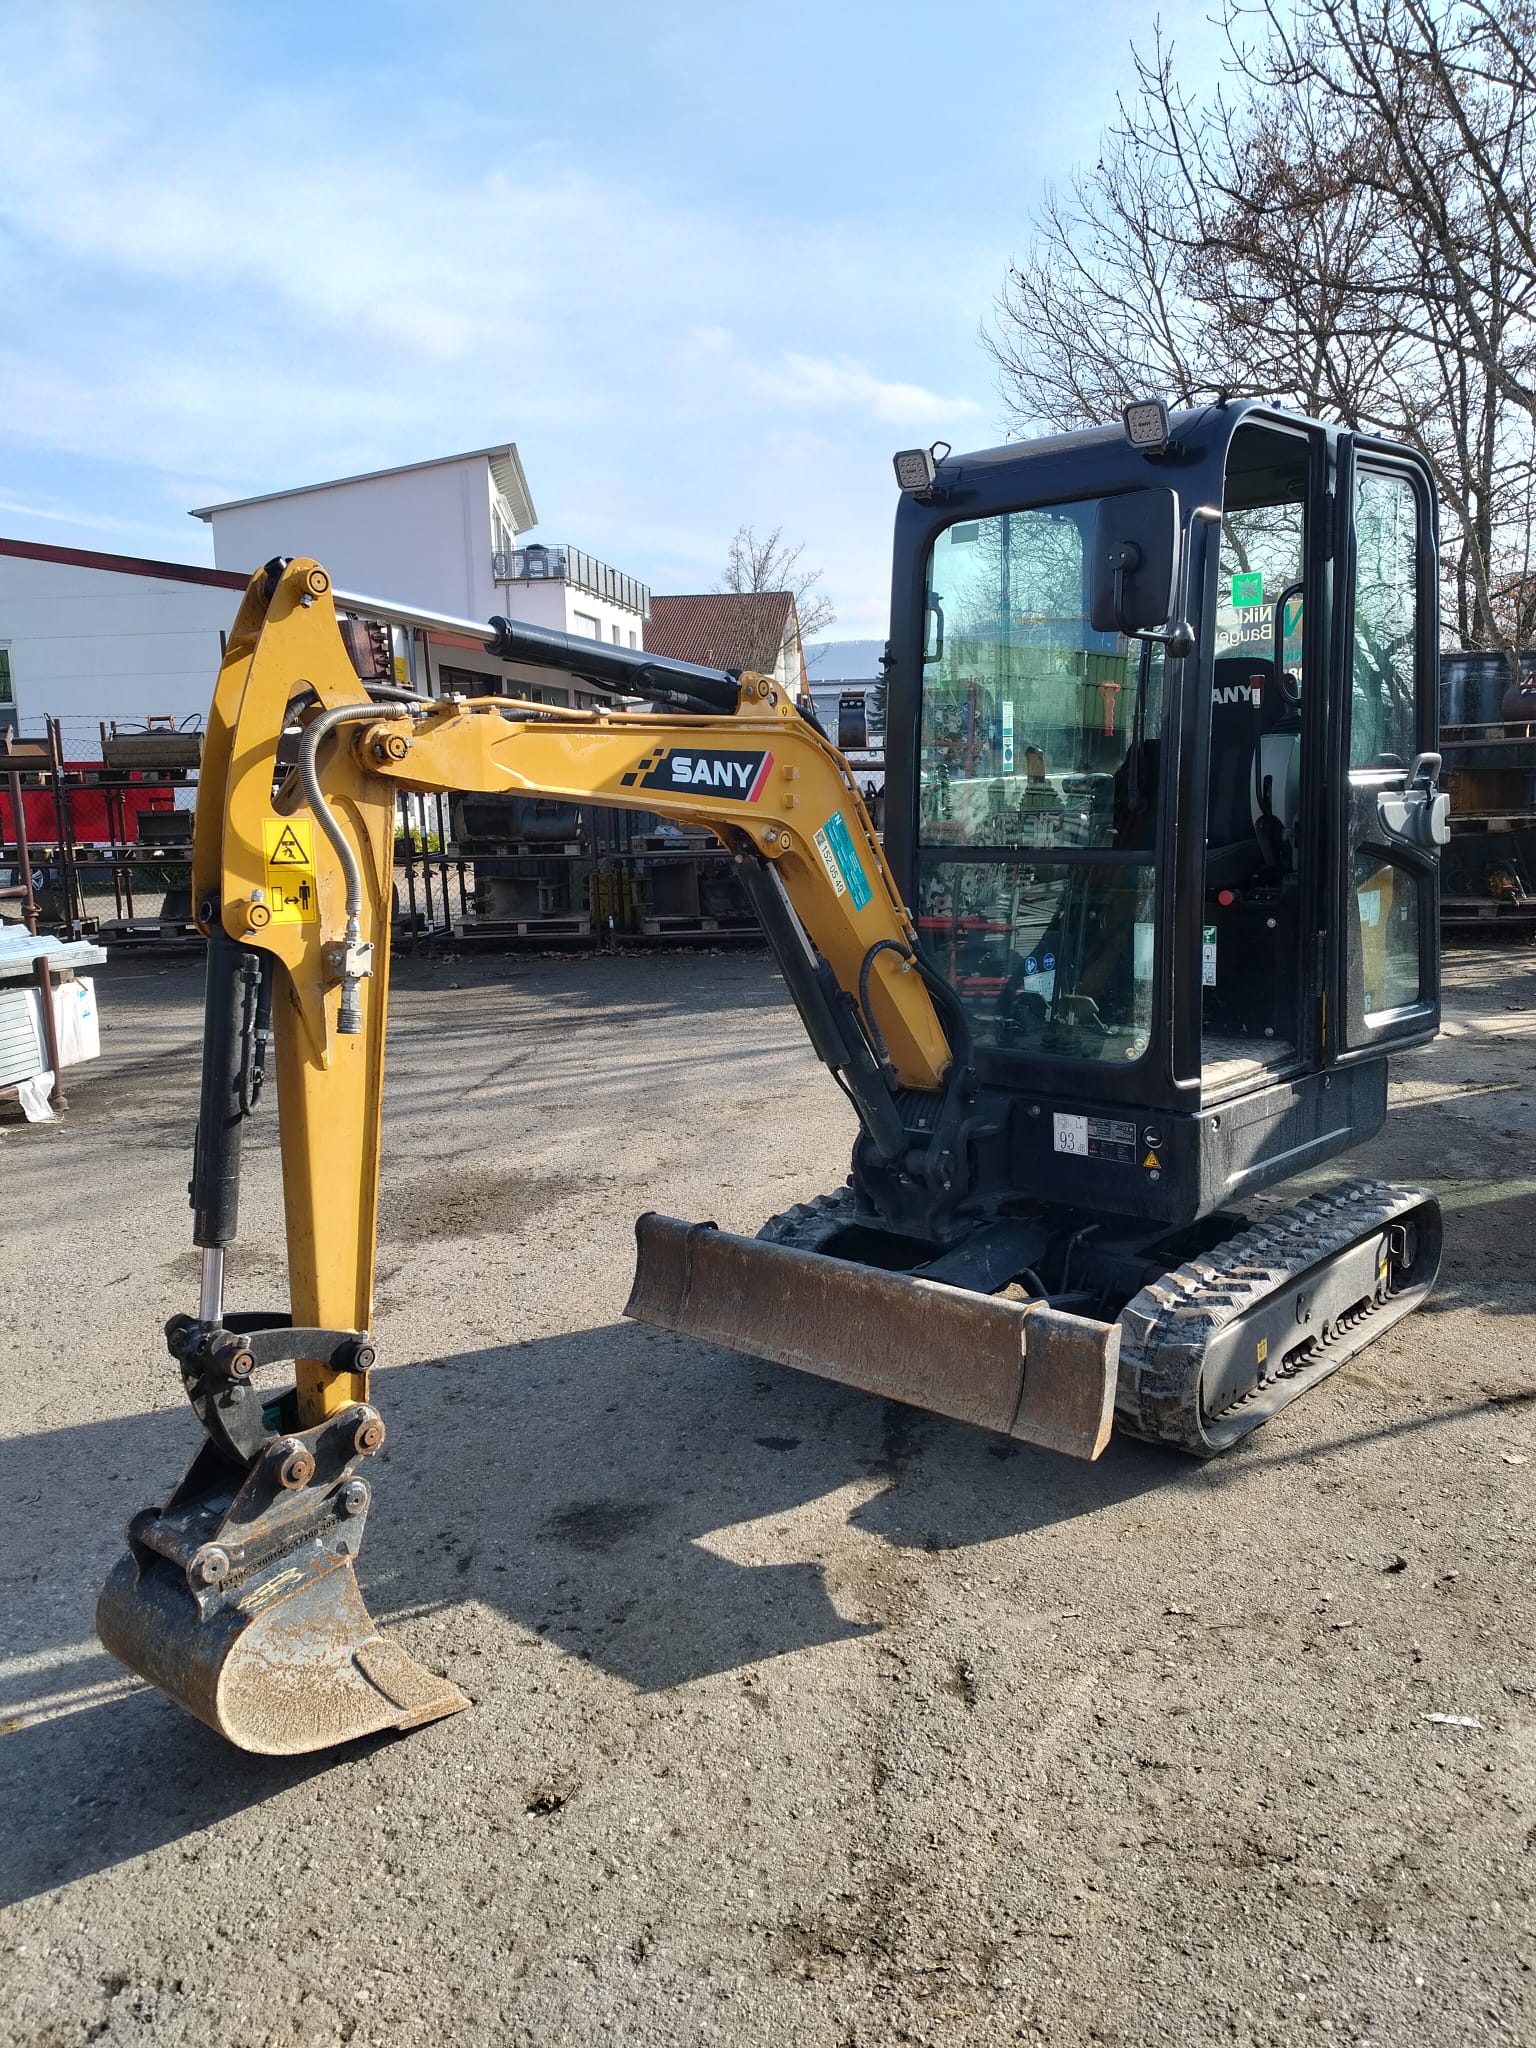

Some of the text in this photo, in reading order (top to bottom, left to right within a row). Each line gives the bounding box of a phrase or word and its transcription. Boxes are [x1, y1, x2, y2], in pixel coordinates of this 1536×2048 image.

[1212, 685, 1252, 704] ANY
[671, 756, 754, 788] SANY
[822, 845, 833, 865] 152
[829, 864, 839, 879] 05
[835, 879, 845, 893] 49
[1060, 1131, 1075, 1150] 93
